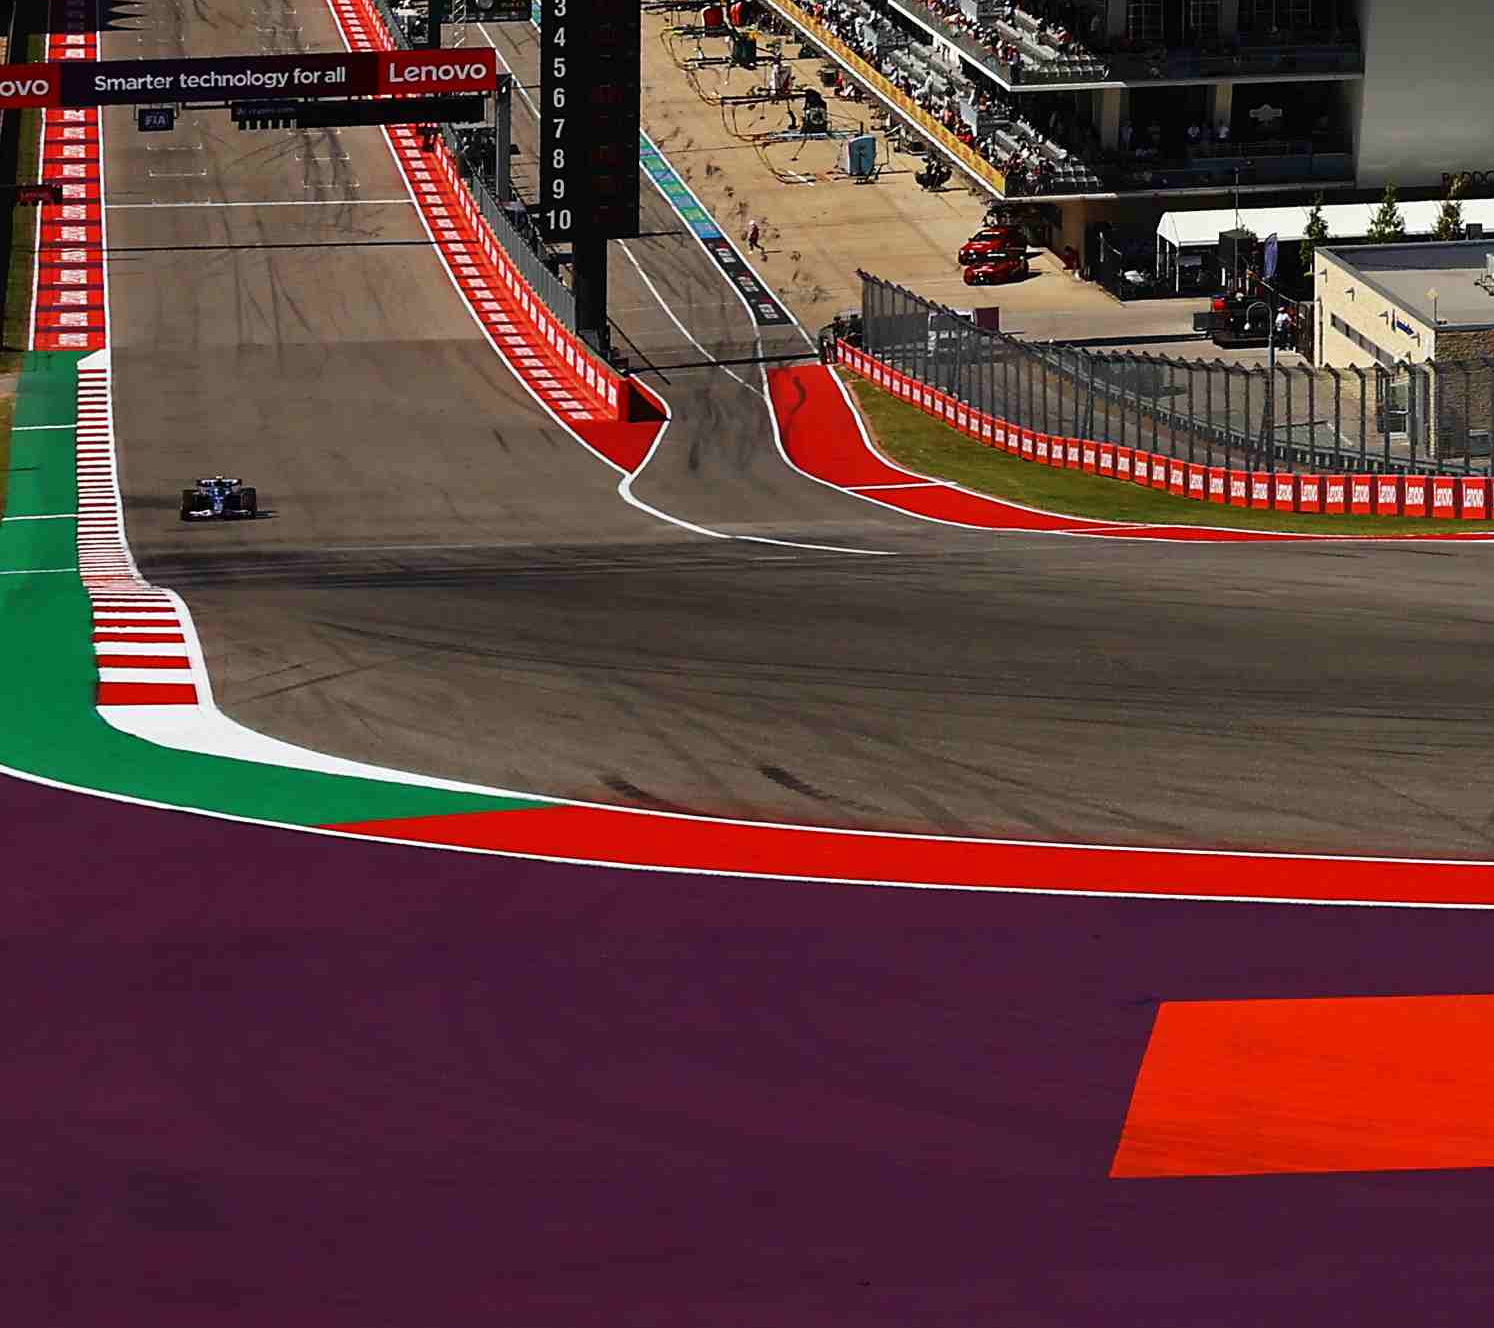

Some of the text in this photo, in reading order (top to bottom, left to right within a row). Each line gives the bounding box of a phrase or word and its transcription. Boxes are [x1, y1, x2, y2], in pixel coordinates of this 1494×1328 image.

[554, 28, 565, 46] 4
[388, 61, 486, 82] Lenovo
[554, 58, 566, 77] 5
[94, 67, 345, 92] Smarter technology for all
[553, 88, 565, 108] 6
[553, 119, 565, 138] 7
[553, 149, 564, 168] 8
[553, 179, 564, 198] 9
[547, 210, 571, 229] 10
[1434, 483, 1452, 507] Lenovo
[1463, 483, 1483, 508] Lenovo
